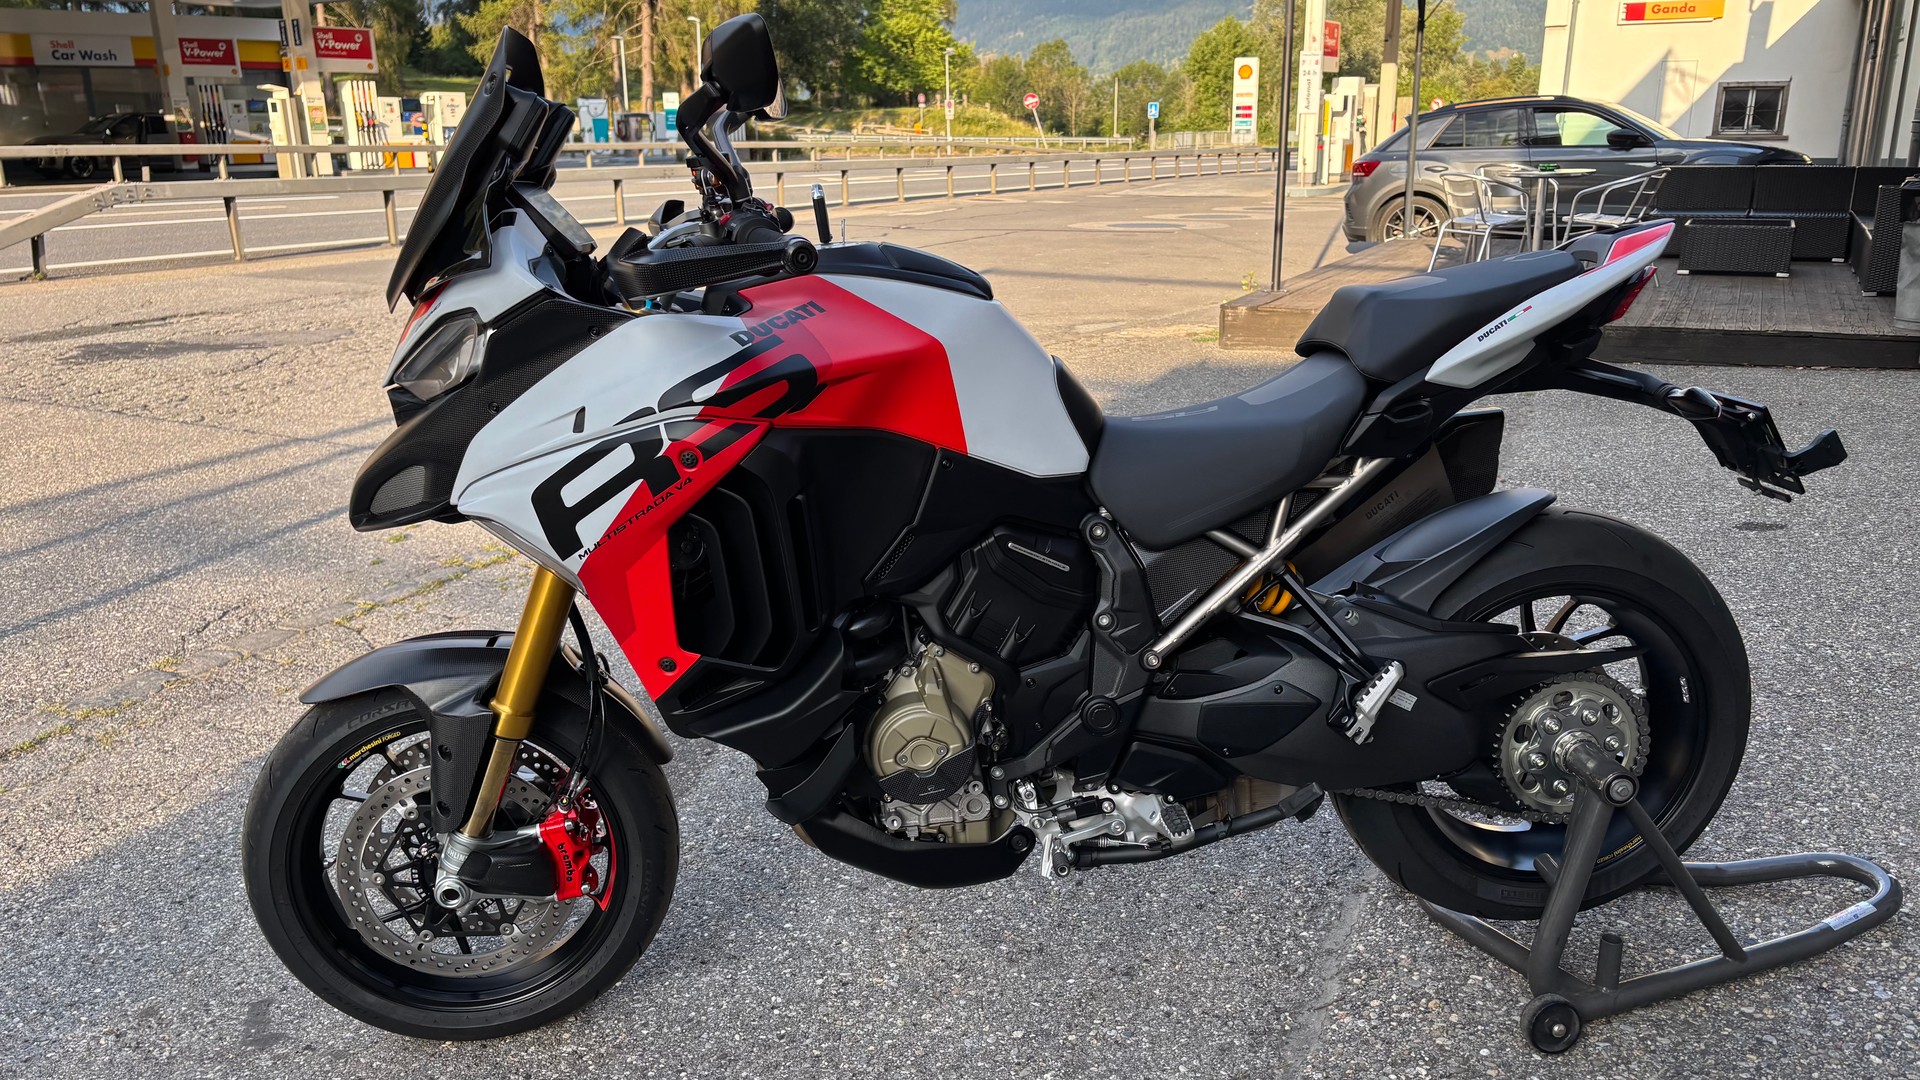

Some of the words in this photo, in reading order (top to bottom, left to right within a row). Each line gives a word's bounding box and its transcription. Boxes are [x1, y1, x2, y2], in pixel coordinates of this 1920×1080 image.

[1651, 2, 1696, 14] Ganda
[49, 40, 75, 48] Shell
[316, 31, 333, 39] Shell
[183, 47, 224, 58] V-Power
[317, 39, 361, 50] V-Power
[51, 49, 75, 60] Car
[79, 49, 117, 61] Wash
[729, 300, 826, 348] DUCATI
[1477, 319, 1508, 343] DUCATI
[1365, 490, 1399, 520] DUCATI
[578, 490, 673, 560] MULTISTRADA
[676, 476, 694, 492] V4
[349, 737, 382, 761] marchesini
[557, 842, 575, 882] brembo
